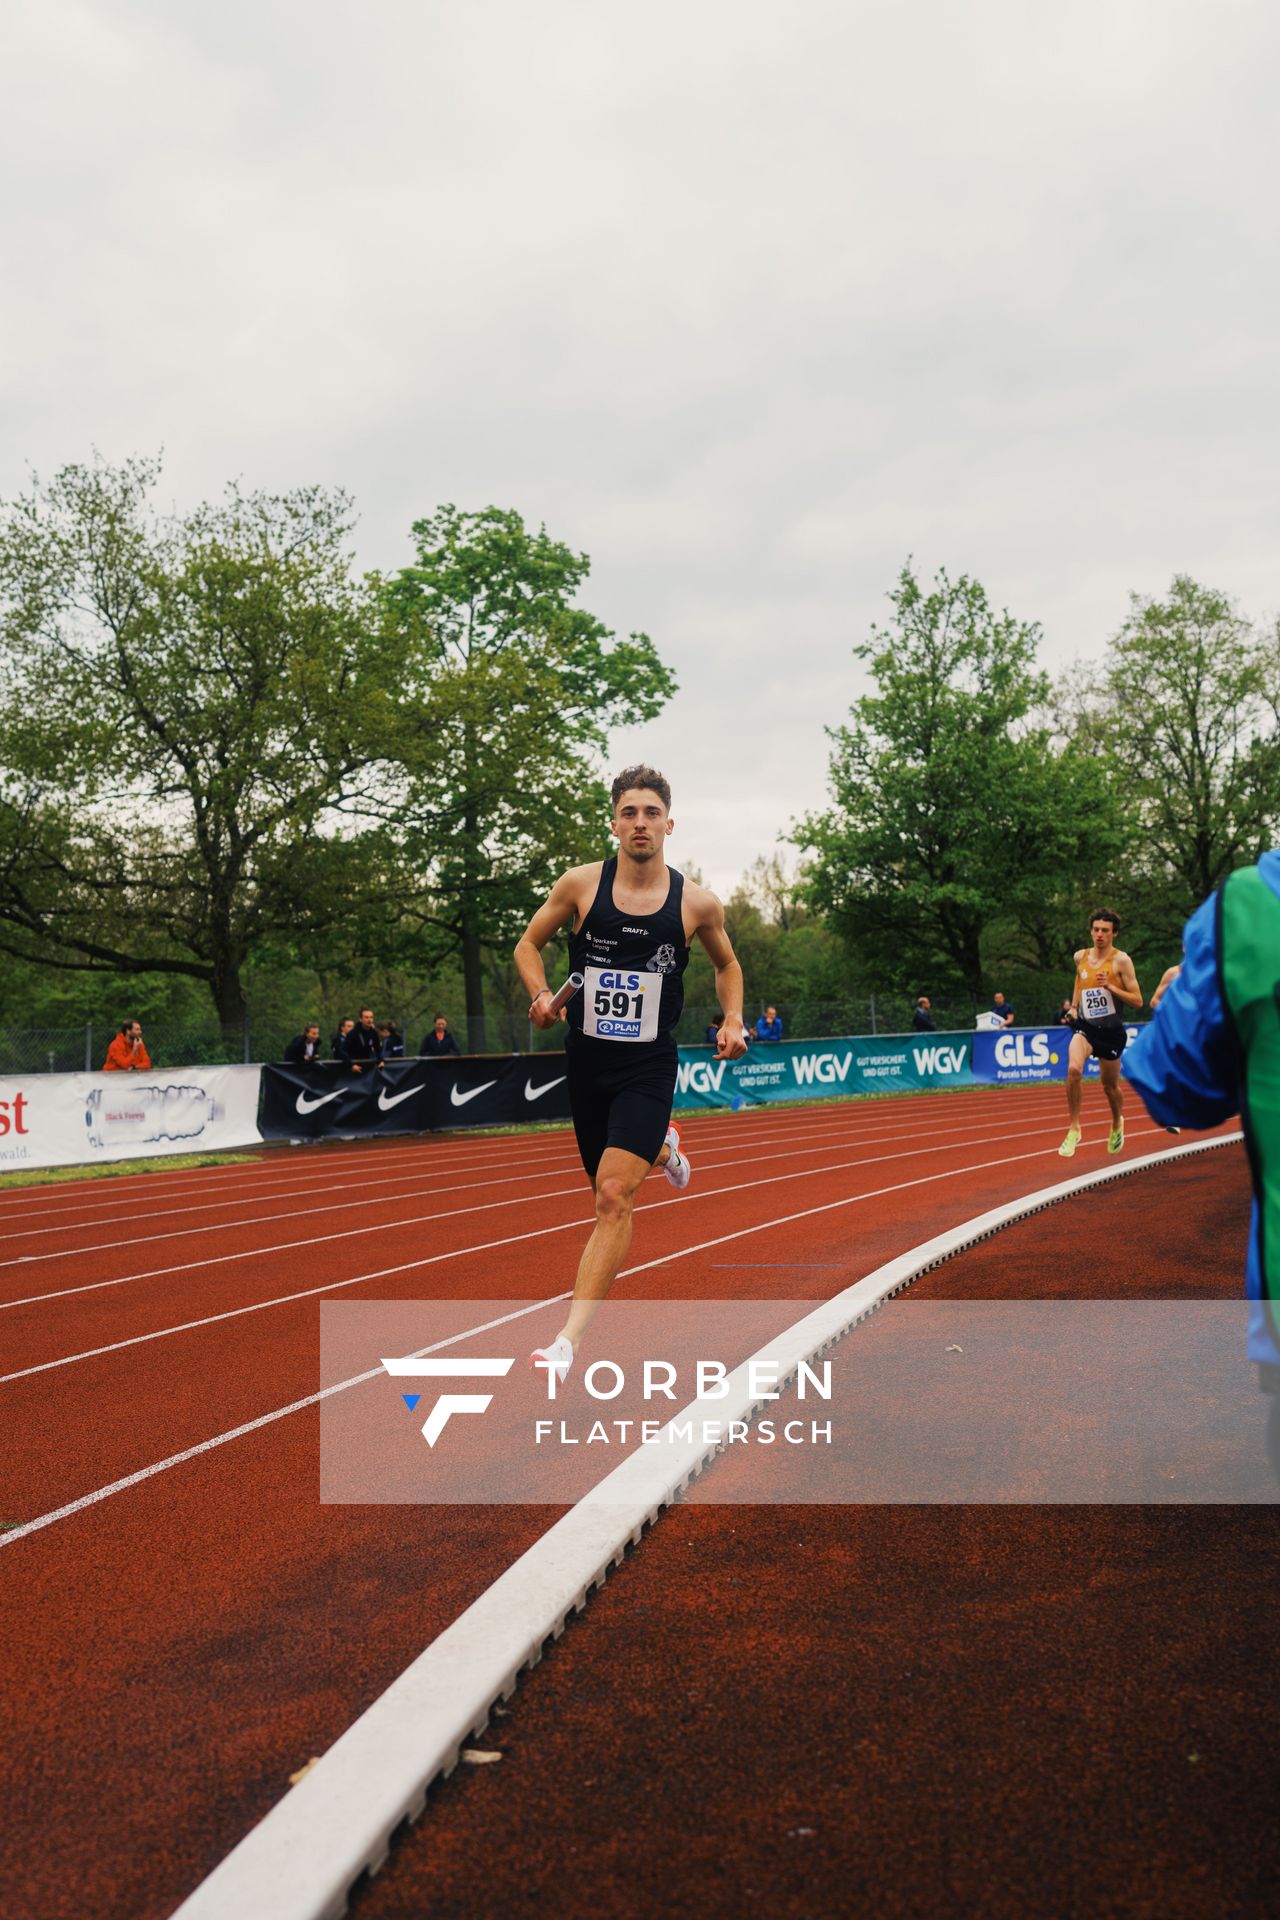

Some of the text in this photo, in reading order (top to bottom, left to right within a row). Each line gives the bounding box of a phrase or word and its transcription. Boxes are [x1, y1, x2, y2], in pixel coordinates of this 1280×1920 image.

[622, 926, 643, 934] CRAFT
[593, 937, 618, 946] Sparkasse
[594, 990, 643, 1019] 591
[1086, 996, 1107, 1009] 250
[614, 1023, 639, 1032] PLAN
[856, 1057, 869, 1066] GUT
[912, 1044, 967, 1076] WGV
[732, 1065, 747, 1075] GUT
[791, 1052, 853, 1085] WGV
[997, 1068, 1051, 1079] Parcels to People
[739, 1077, 755, 1087] UND
[756, 1076, 769, 1085] GUT
